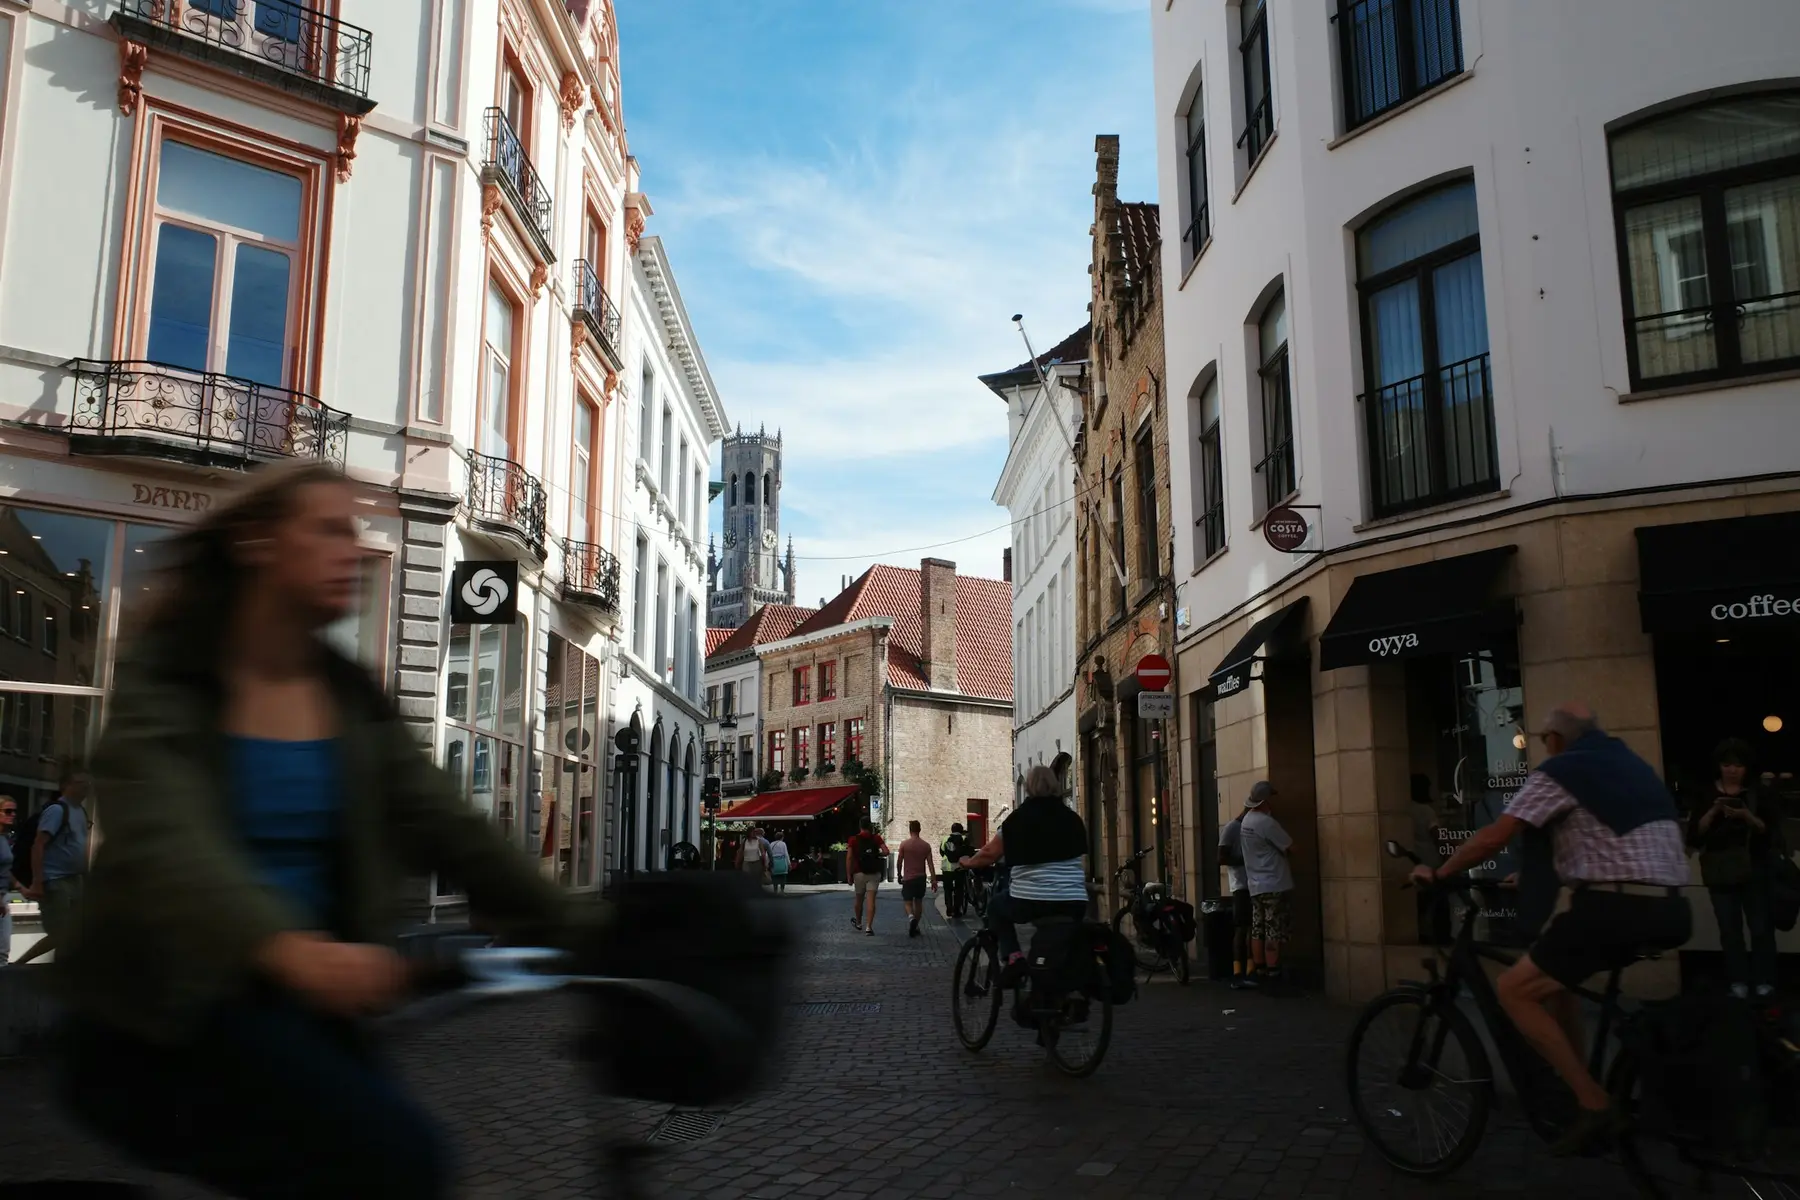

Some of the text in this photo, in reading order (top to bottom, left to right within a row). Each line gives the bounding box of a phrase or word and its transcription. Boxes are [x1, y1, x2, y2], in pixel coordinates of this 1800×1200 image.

[1270, 524, 1304, 533] COSTA
[1368, 632, 1419, 656] oyya
[1217, 675, 1240, 695] waffles
[1495, 759, 1528, 775] Belg
[1487, 775, 1528, 788] cham
[1437, 827, 1476, 840] Euro
